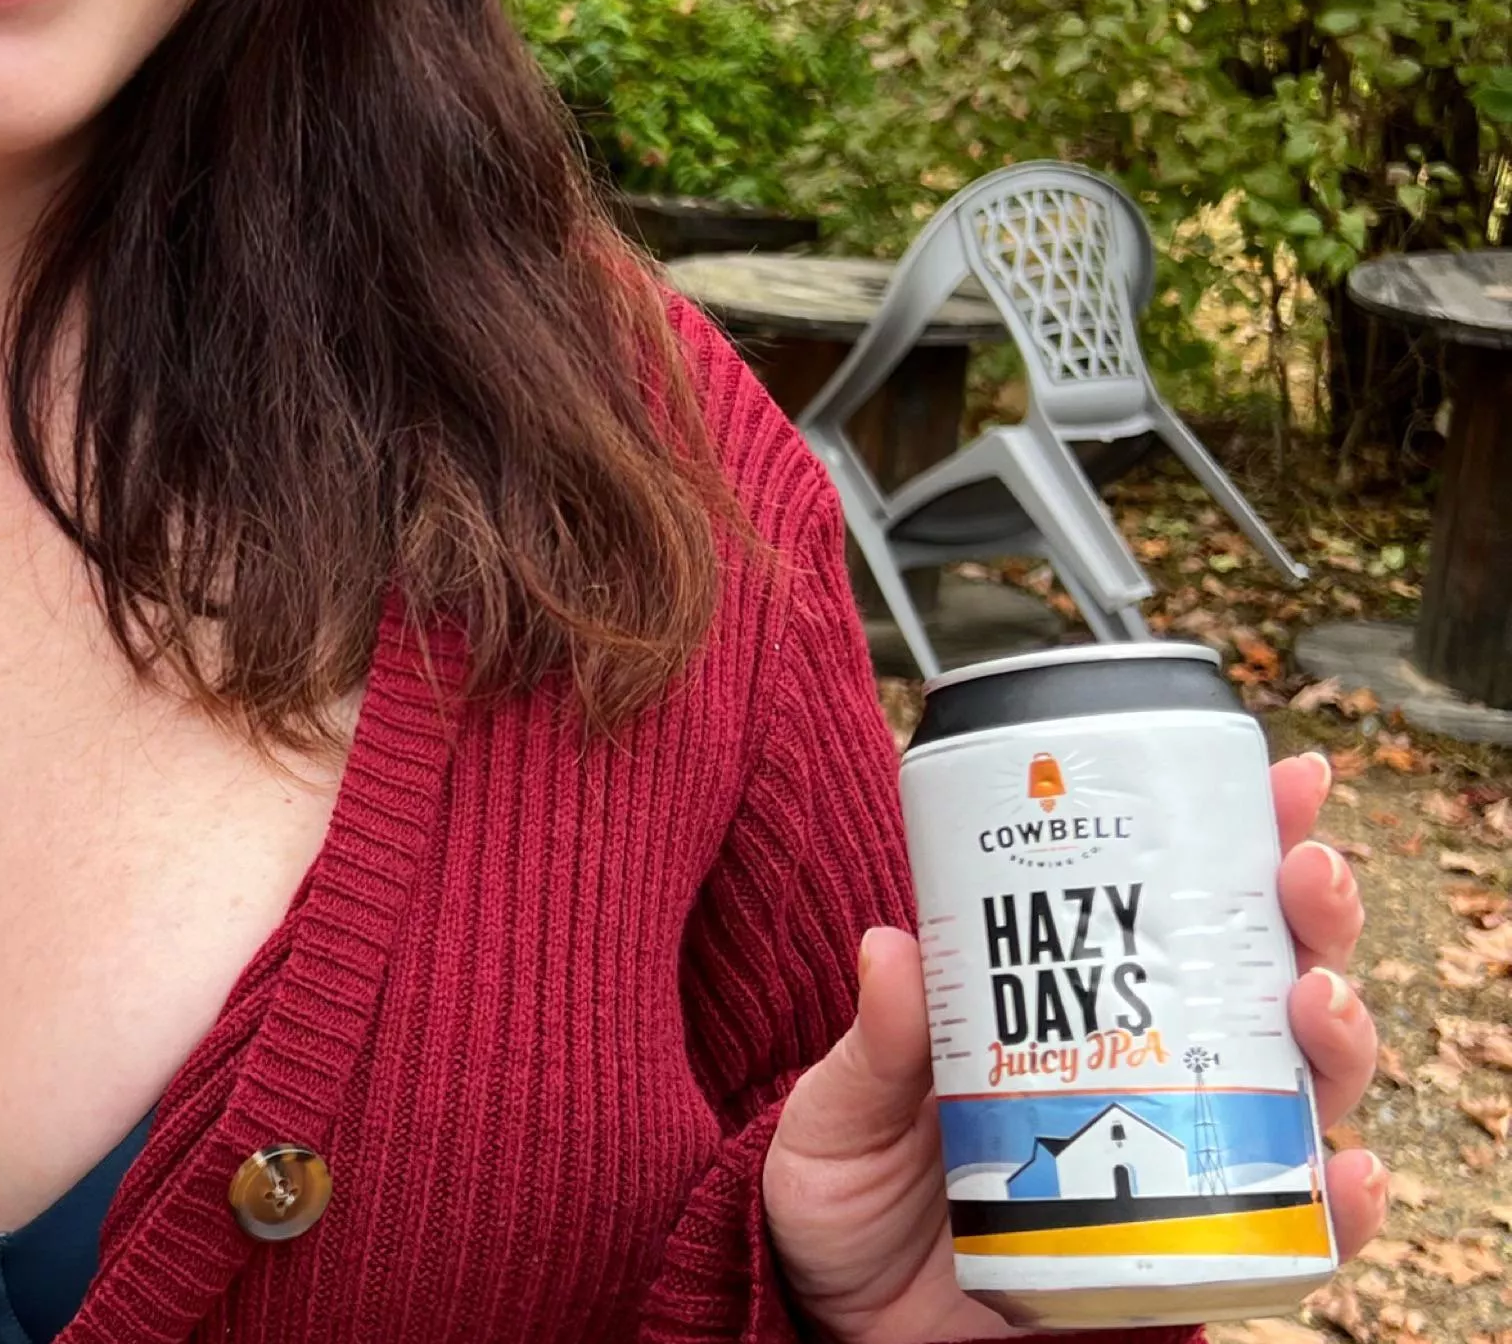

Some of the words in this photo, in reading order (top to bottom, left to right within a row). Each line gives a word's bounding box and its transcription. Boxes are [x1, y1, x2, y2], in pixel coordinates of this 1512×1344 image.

[982, 882, 1143, 969] HAZY
[991, 962, 1152, 1046] DAYS
[988, 1041, 1079, 1087] Juicy
[1087, 1029, 1171, 1070] IPA
